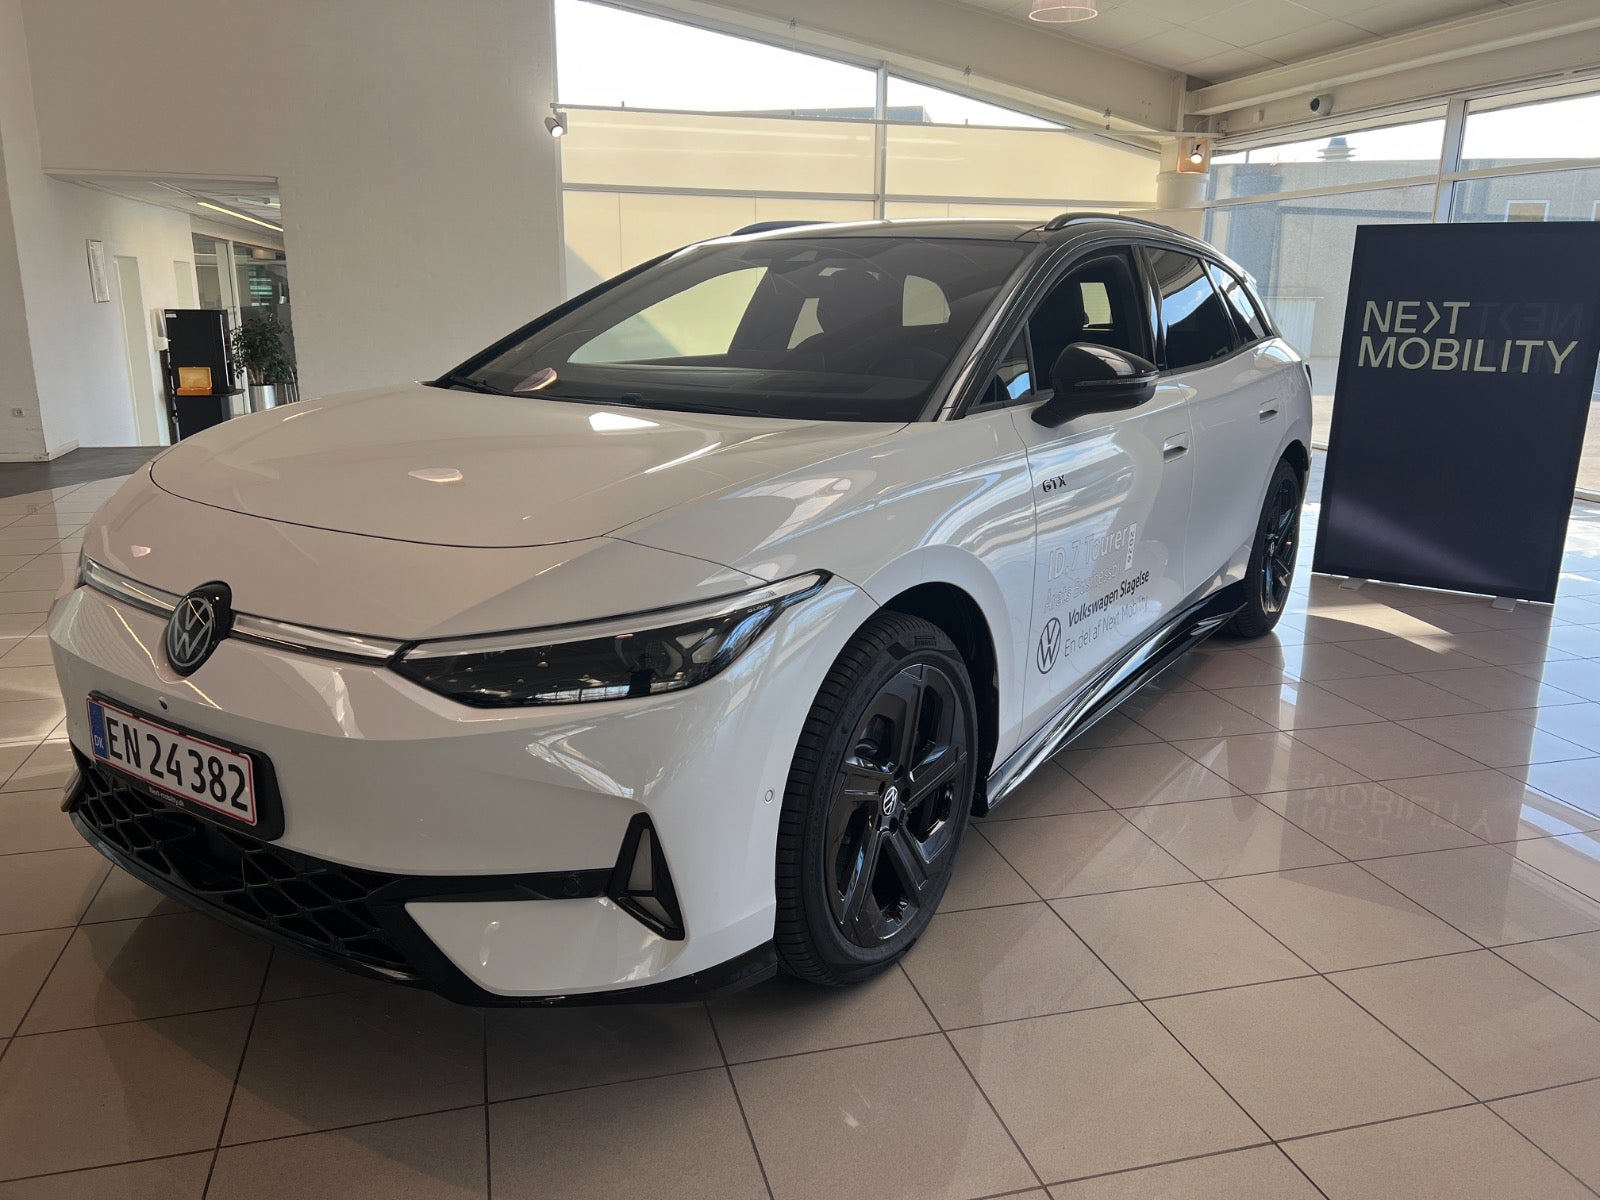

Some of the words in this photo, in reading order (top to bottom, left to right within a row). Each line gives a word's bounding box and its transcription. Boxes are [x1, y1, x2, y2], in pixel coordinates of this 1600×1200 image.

[1357, 335, 1579, 375] MOBILITY
[1042, 474, 1067, 493] GTX
[1085, 527, 1128, 565] Tourer
[1068, 588, 1118, 627] Volkswagen
[1120, 569, 1150, 597] Slagelse
[1064, 638, 1076, 657] En
[1078, 630, 1091, 648] del
[1102, 613, 1119, 634] Next
[1121, 594, 1149, 622] Mobility
[94, 734, 105, 751] DK
[105, 716, 142, 769] EN
